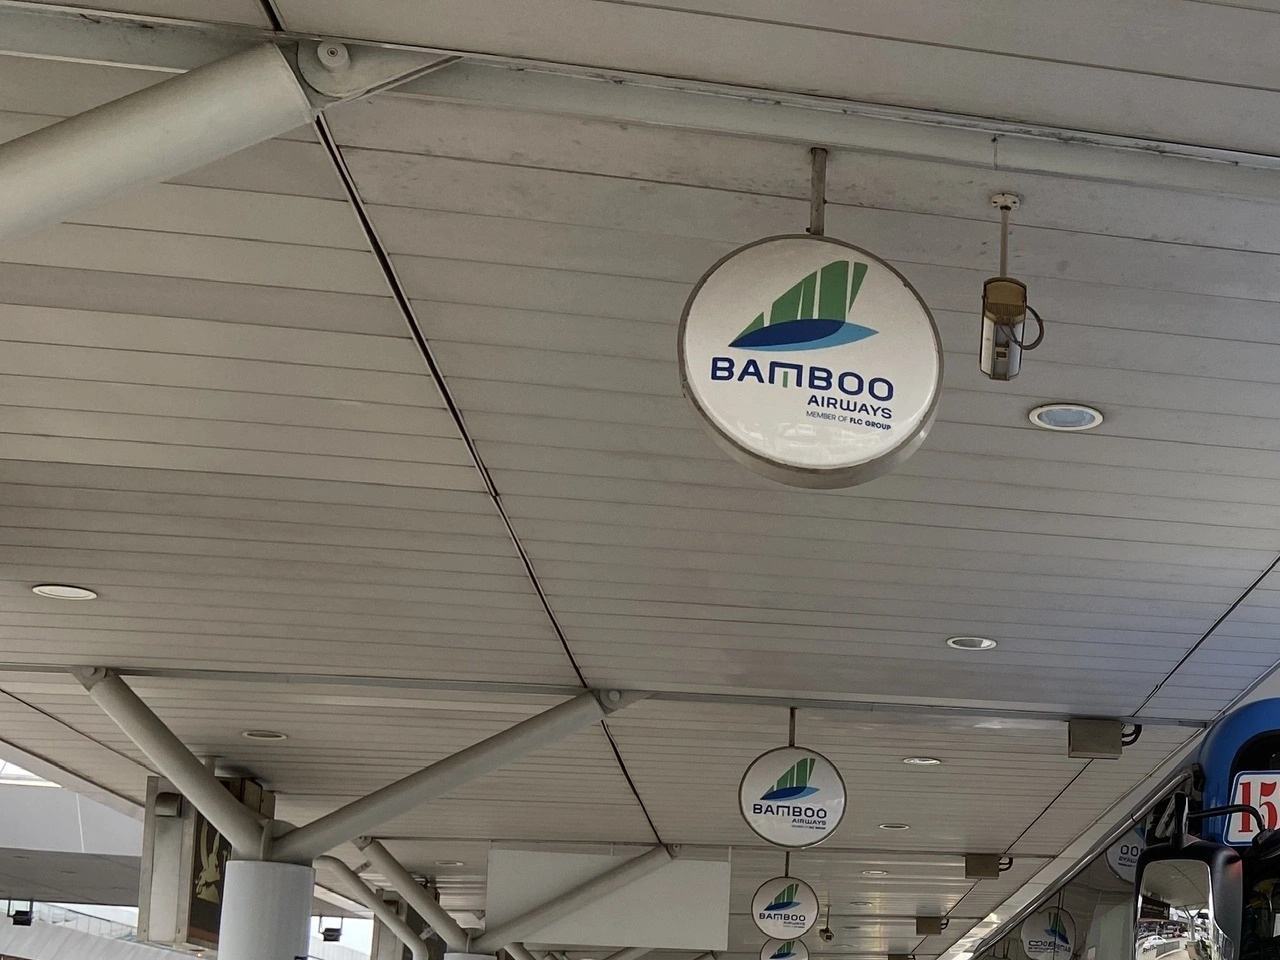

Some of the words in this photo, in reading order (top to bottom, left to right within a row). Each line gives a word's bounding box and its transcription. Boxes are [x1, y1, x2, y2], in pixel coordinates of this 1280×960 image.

[710, 356, 894, 402] BAMBOO
[806, 394, 893, 420] AIRWAYS
[805, 410, 837, 421] MEMBER
[849, 416, 863, 426] FLC
[865, 419, 892, 431] GROUP
[753, 803, 827, 819] BAMBOO
[791, 818, 827, 826] AIRWAYS
[759, 912, 806, 922] BAMBOO
